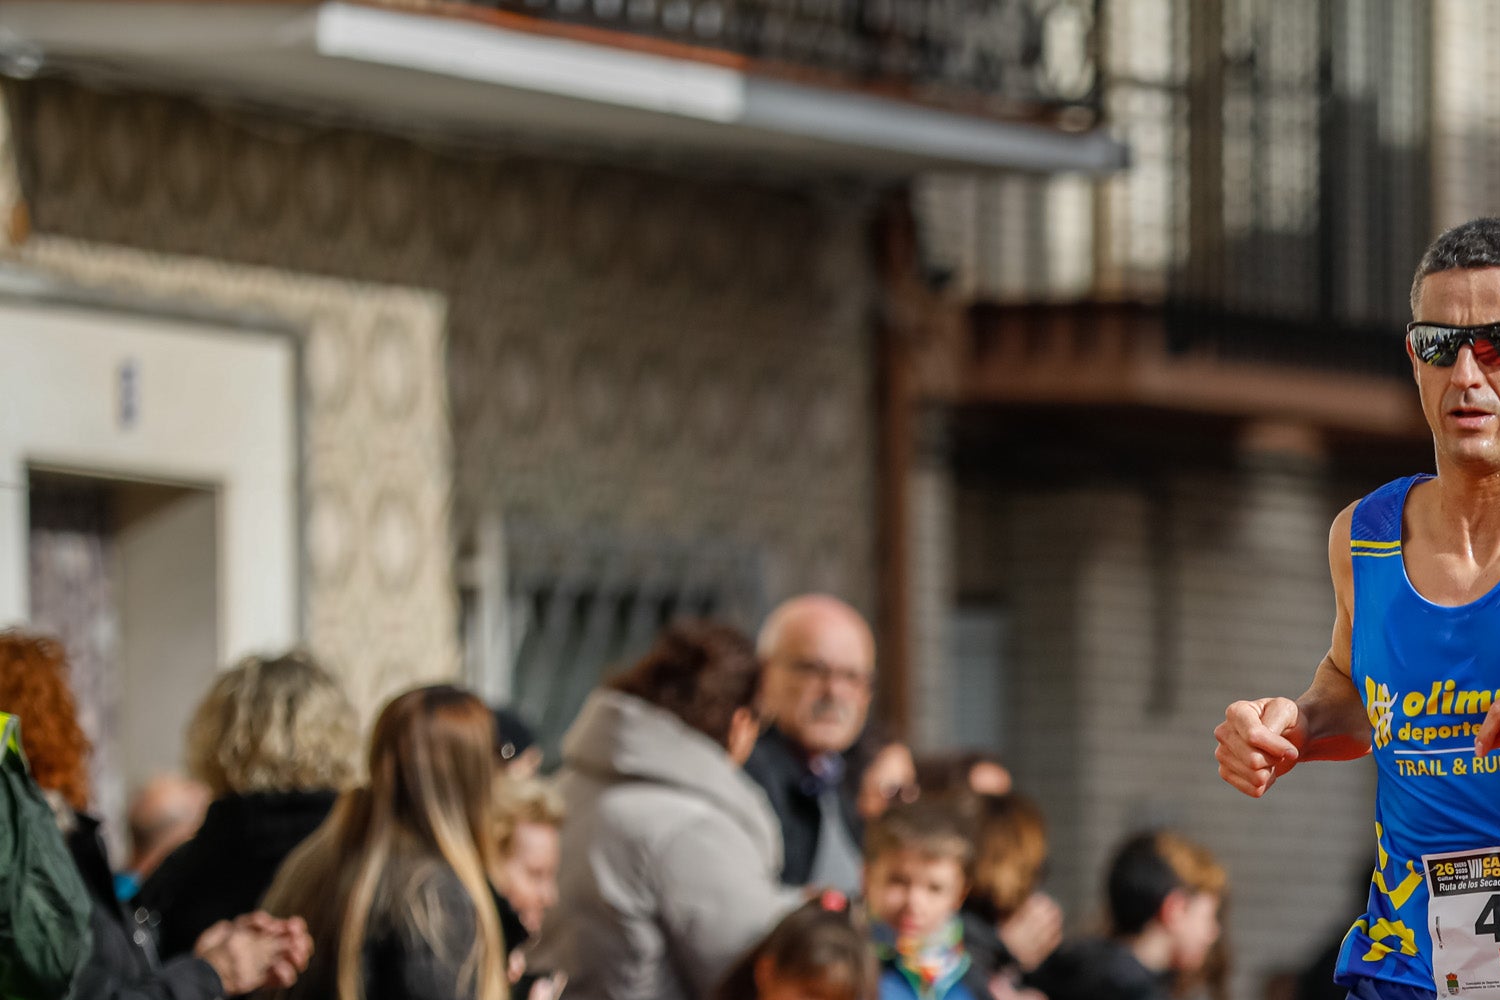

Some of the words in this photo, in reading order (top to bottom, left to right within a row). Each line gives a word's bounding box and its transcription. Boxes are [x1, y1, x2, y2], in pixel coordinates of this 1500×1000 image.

[1398, 721, 1481, 744] deporte
[1395, 759, 1447, 777] TRAIL
[1452, 757, 1467, 775] &
[1436, 863, 1454, 876] 26
[1440, 882, 1456, 892] Ruta
[1458, 881, 1467, 890] de
[1468, 880, 1478, 888] los
